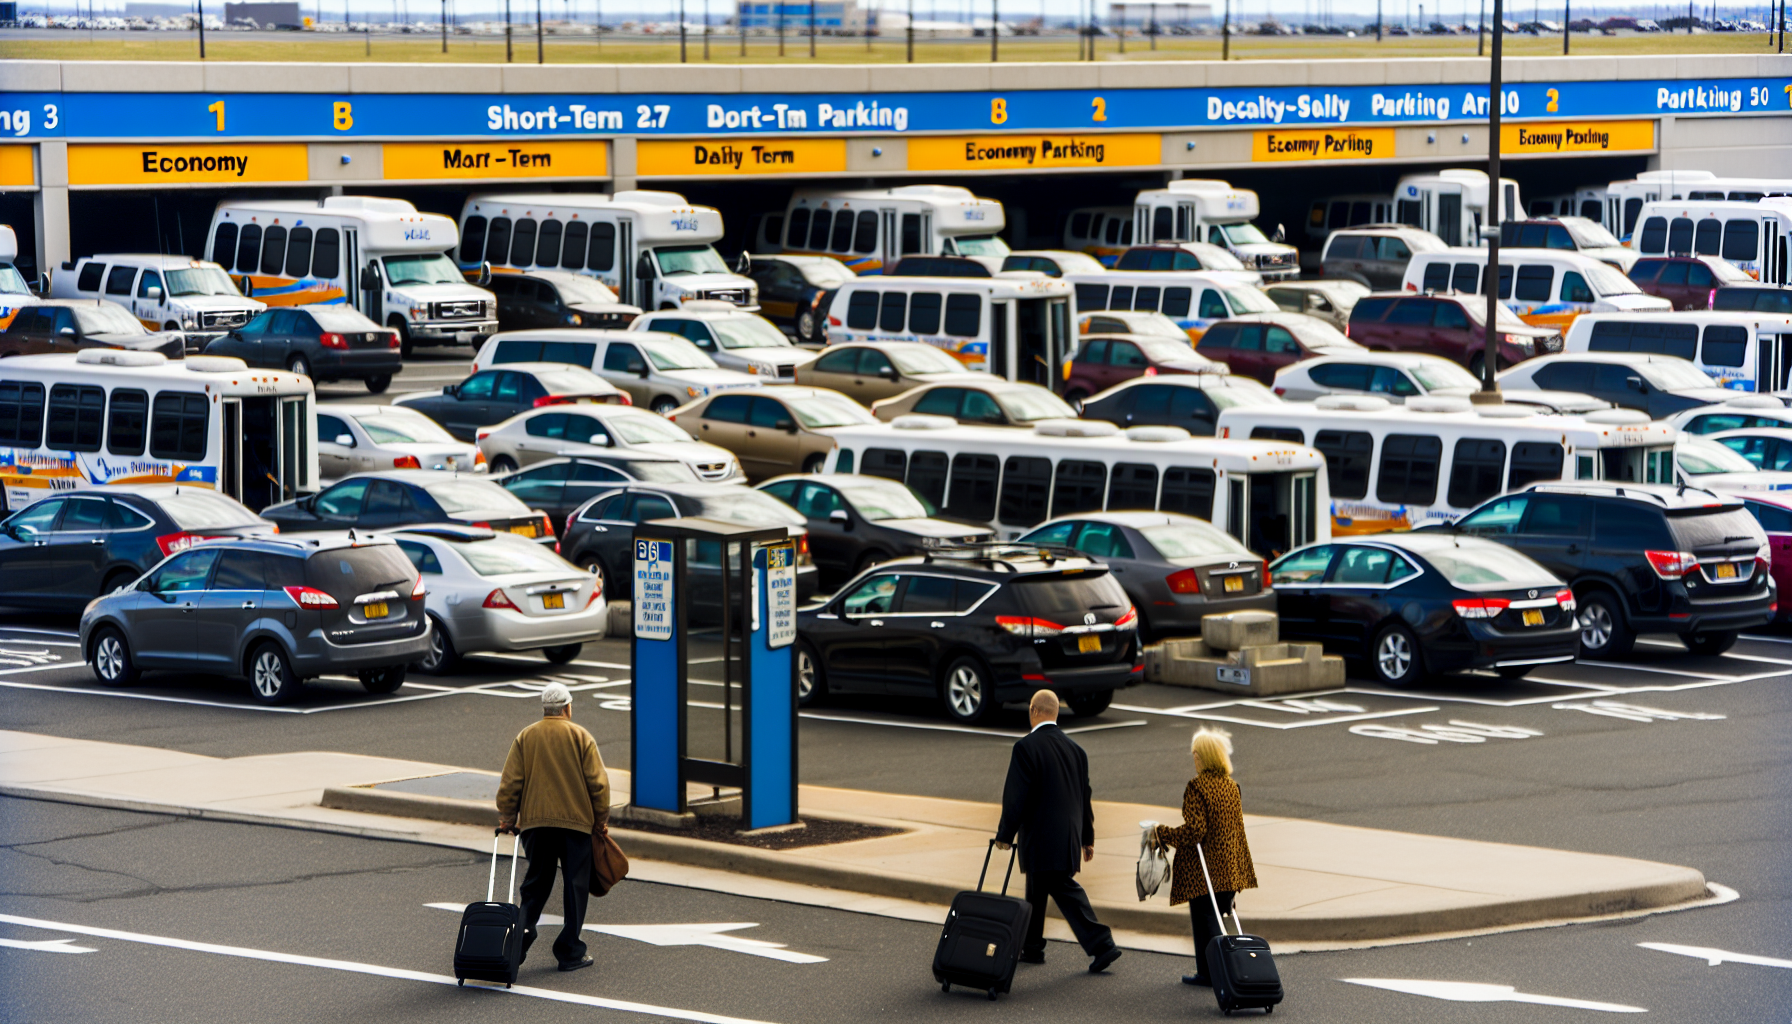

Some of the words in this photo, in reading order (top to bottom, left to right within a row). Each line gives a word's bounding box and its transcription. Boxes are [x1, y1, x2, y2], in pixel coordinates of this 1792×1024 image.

[43, 103, 59, 129] 3
[207, 100, 225, 131] 1
[333, 101, 354, 131] B
[817, 100, 909, 131] Parking
[1091, 96, 1107, 122] 2
[141, 151, 248, 177] Economy
